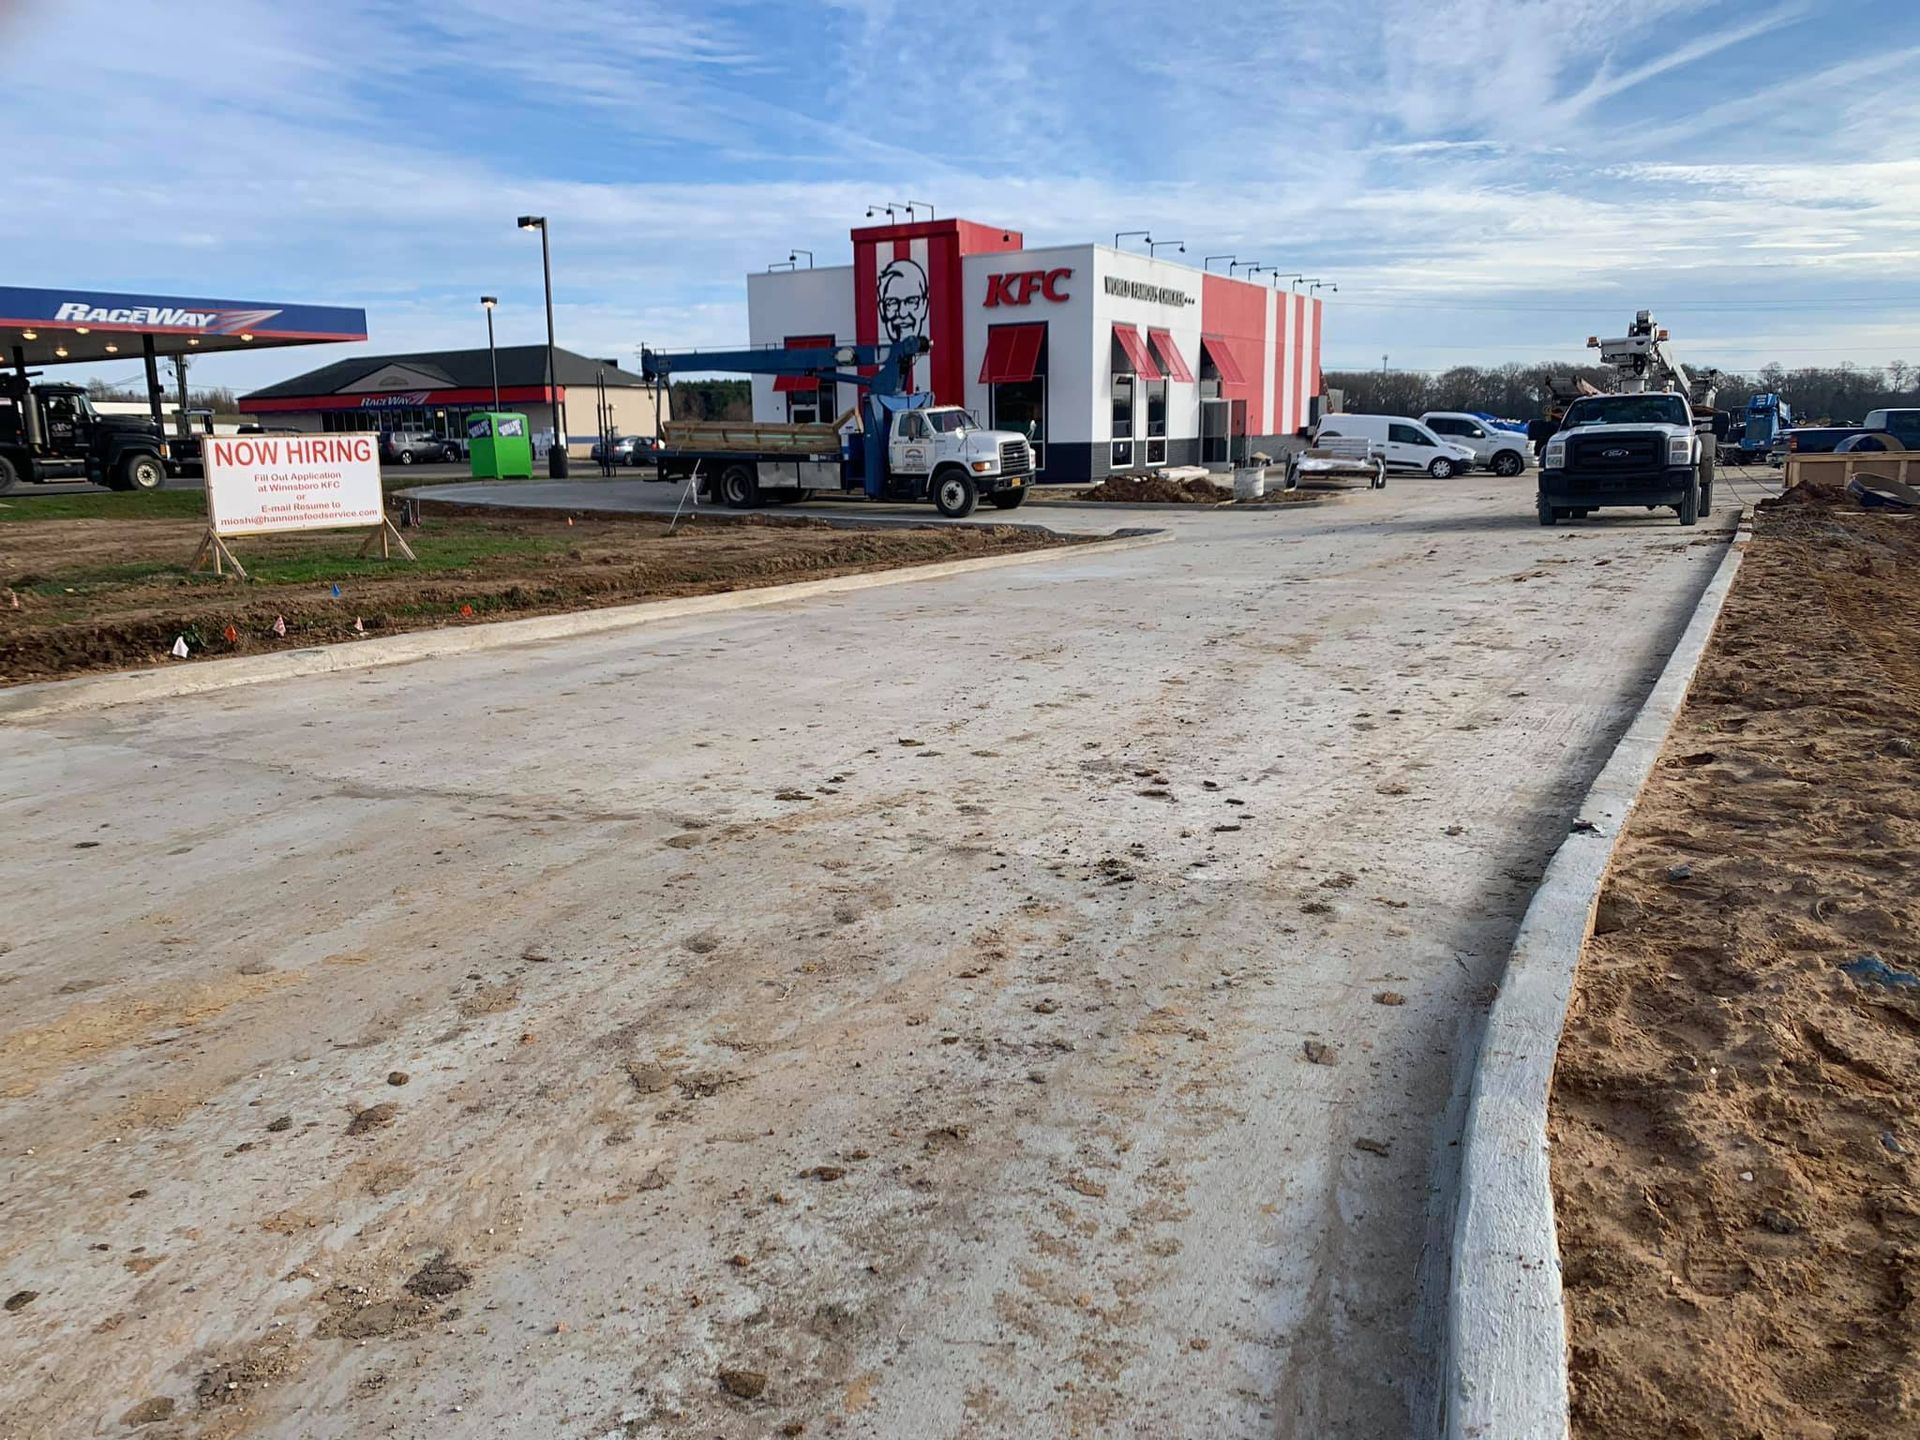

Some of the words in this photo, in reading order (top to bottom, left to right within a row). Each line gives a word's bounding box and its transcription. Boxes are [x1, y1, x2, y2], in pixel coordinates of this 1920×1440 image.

[983, 267, 1072, 307] KFC
[1104, 276, 1130, 298] WORLD
[1131, 281, 1158, 302] FAMOUS
[214, 440, 278, 467] NOW
[286, 439, 371, 465] HIRING
[254, 474, 269, 482] Fill
[271, 473, 288, 481] Out
[290, 471, 342, 482] Application
[257, 484, 268, 493] at
[269, 482, 319, 492] Winnsboro
[321, 481, 341, 489] KFC
[261, 503, 291, 513] E-mail
[293, 502, 330, 511] Resume
[331, 501, 341, 509] to
